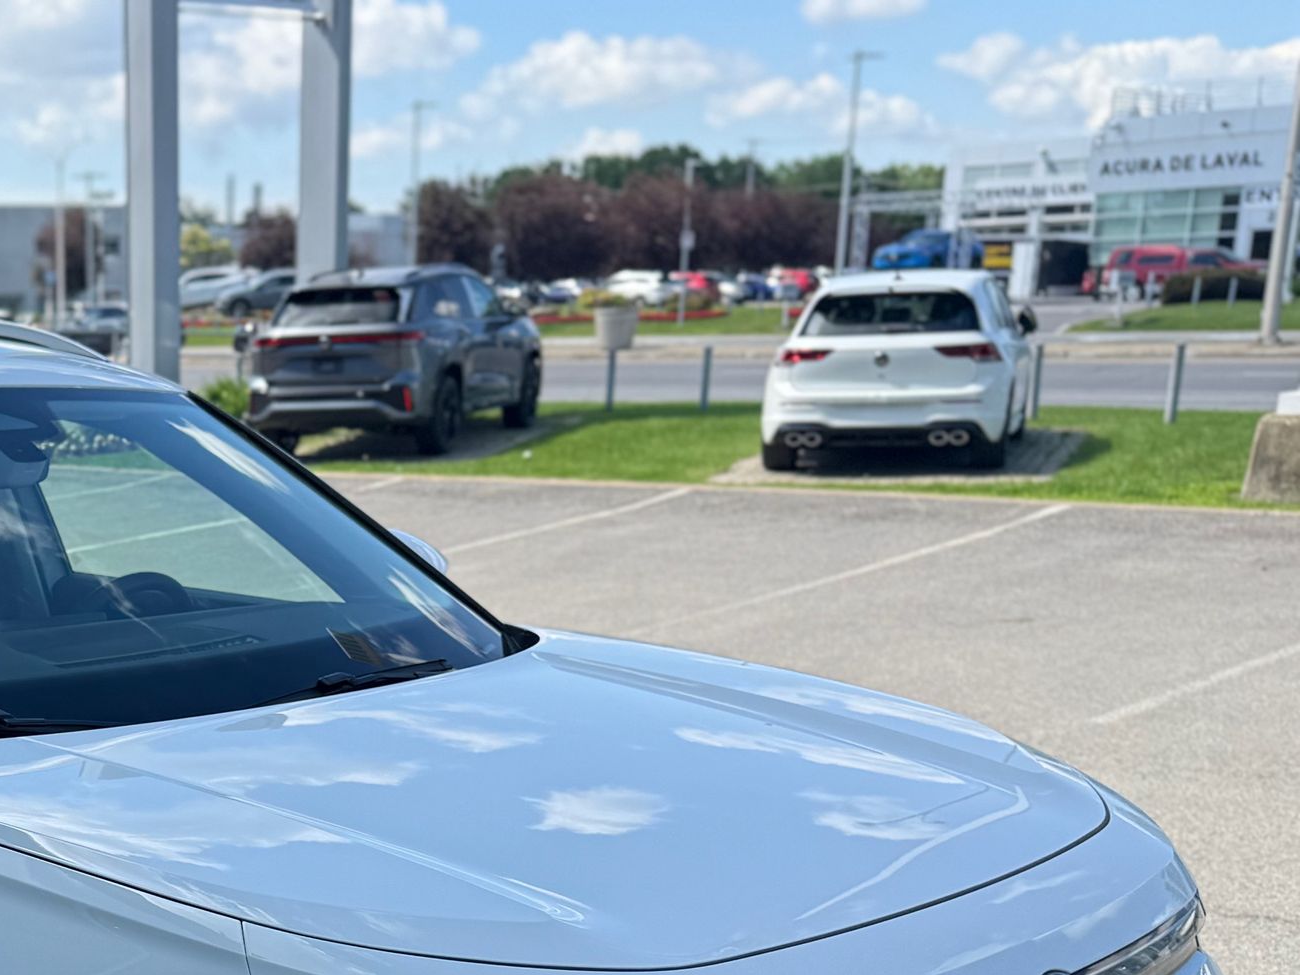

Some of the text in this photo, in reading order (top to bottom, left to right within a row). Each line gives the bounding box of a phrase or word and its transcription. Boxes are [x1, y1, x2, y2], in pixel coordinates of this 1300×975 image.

[1100, 151, 1263, 176] ACURA DE LAVAL
